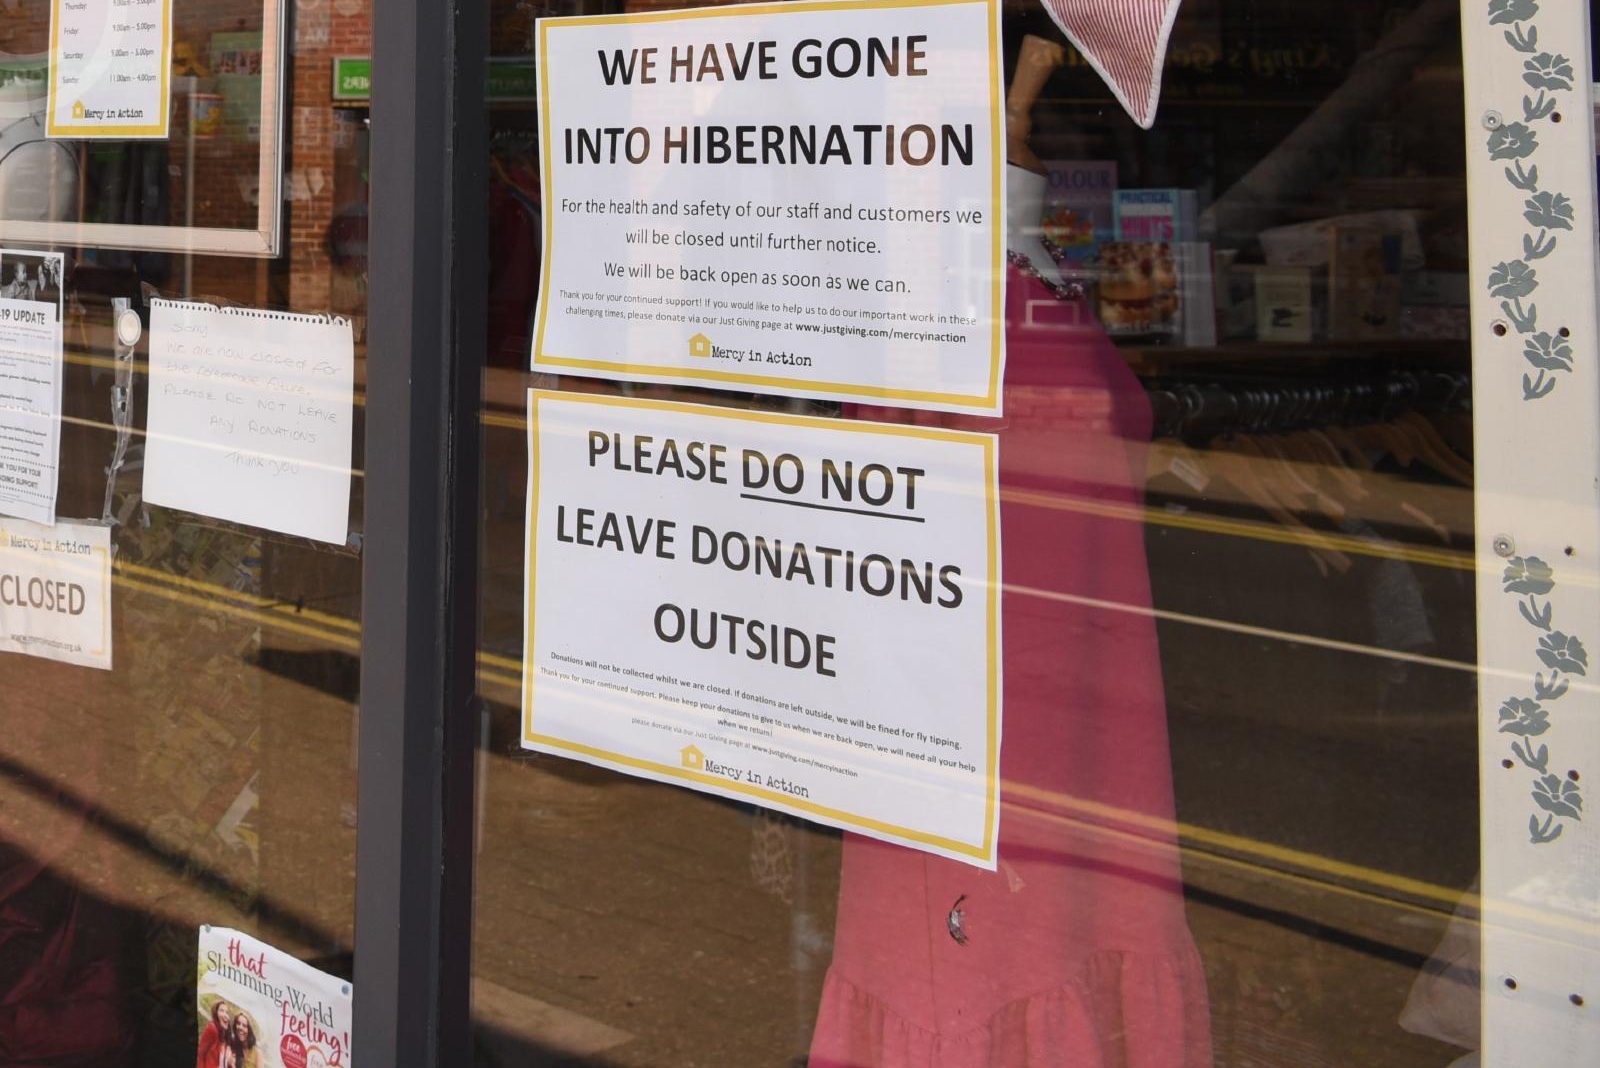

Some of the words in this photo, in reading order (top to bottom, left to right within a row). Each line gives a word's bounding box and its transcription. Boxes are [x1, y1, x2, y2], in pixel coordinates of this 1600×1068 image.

[597, 47, 658, 85] WE
[669, 40, 778, 82] HAVE
[791, 34, 928, 78] GONE
[84, 109, 104, 120] Mercy
[107, 109, 116, 118] in
[118, 108, 143, 118] Action
[564, 126, 650, 164] INTO
[663, 123, 973, 165] HIBERNATION
[561, 197, 583, 213] For
[585, 198, 606, 214] the
[608, 198, 648, 214] health
[651, 199, 678, 215] and
[683, 199, 731, 219] safety
[735, 200, 752, 217] of
[755, 205, 783, 218] our
[786, 201, 819, 219] staff
[823, 203, 852, 220] and
[857, 207, 951, 223] customers
[955, 210, 982, 224] we
[625, 228, 648, 243] will
[651, 228, 669, 245] be
[673, 230, 724, 247] closed
[729, 232, 763, 248] until
[767, 232, 823, 251] further
[825, 236, 881, 253] notice.
[603, 261, 625, 277] We
[627, 262, 651, 278] will
[655, 263, 675, 280] be
[679, 264, 716, 282] back
[720, 270, 757, 286] open
[761, 272, 777, 285] as
[781, 273, 821, 287] soon
[825, 275, 842, 289] as
[845, 277, 870, 291] we
[874, 279, 911, 293] can.
[13, 311, 45, 324] UPDATE
[560, 288, 580, 299] Thank
[582, 292, 594, 301] you
[595, 290, 605, 301] for
[606, 293, 623, 302] your
[624, 294, 663, 304] continued
[666, 297, 702, 307] support!
[704, 297, 712, 307] If
[713, 300, 729, 309] you
[730, 300, 754, 310] would
[756, 300, 770, 311] like
[772, 302, 781, 312] to
[782, 302, 803, 315] help
[805, 306, 816, 315] us
[818, 306, 829, 315] to
[830, 305, 841, 317] do
[843, 308, 858, 317] our
[860, 308, 907, 320] important
[909, 312, 935, 323] work
[938, 315, 947, 324] in
[949, 313, 977, 326] these
[566, 305, 603, 318] challenging
[604, 309, 626, 319] times,
[628, 309, 653, 320] please
[656, 311, 686, 322] donate
[688, 314, 701, 323] via
[702, 316, 717, 324] our
[719, 315, 735, 326] Just
[736, 316, 760, 329] Giving
[761, 320, 782, 331] page
[784, 321, 793, 330] at
[795, 323, 966, 342] www.justgiving.com/mercyinaction
[711, 345, 745, 362] Mercy
[747, 349, 762, 362] in
[765, 350, 812, 366] Action
[6, 463, 17, 471] YOU
[18, 465, 28, 473] FOR
[29, 468, 41, 476] YOUR
[588, 431, 727, 483] PLEASE
[741, 448, 805, 494] DO
[821, 458, 925, 509] NOT
[10, 534, 39, 551] Mercy
[42, 538, 52, 551] in
[55, 540, 91, 555] Action
[556, 505, 676, 559] LEAVE
[691, 526, 963, 607] DONATIONS
[0, 574, 85, 615] CLOSED
[653, 603, 836, 676] OUTSIDE
[550, 651, 584, 666] Donations
[584, 659, 597, 668] will
[598, 663, 611, 671] not
[612, 663, 621, 674] be
[622, 667, 654, 680] collected
[656, 674, 678, 685] whilst
[680, 679, 691, 687] we
[692, 682, 705, 691] are
[706, 683, 733, 695] closed.
[734, 689, 740, 698] If
[741, 691, 777, 706] donations
[778, 701, 790, 710] are
[790, 702, 803, 713] left
[805, 708, 835, 722] outside,
[836, 715, 849, 725] we
[850, 718, 865, 728] will
[866, 720, 877, 731] be
[878, 723, 900, 736] fined
[902, 727, 915, 738] for
[916, 731, 927, 743] fly
[930, 734, 962, 750] tipping.
[704, 758, 744, 780] Mercy
[745, 767, 763, 786] in
[765, 774, 810, 799] Action
[227, 937, 267, 980] that
[206, 950, 283, 1008] Slimming
[286, 985, 334, 1029] World
[280, 1000, 349, 1067] feeling!
